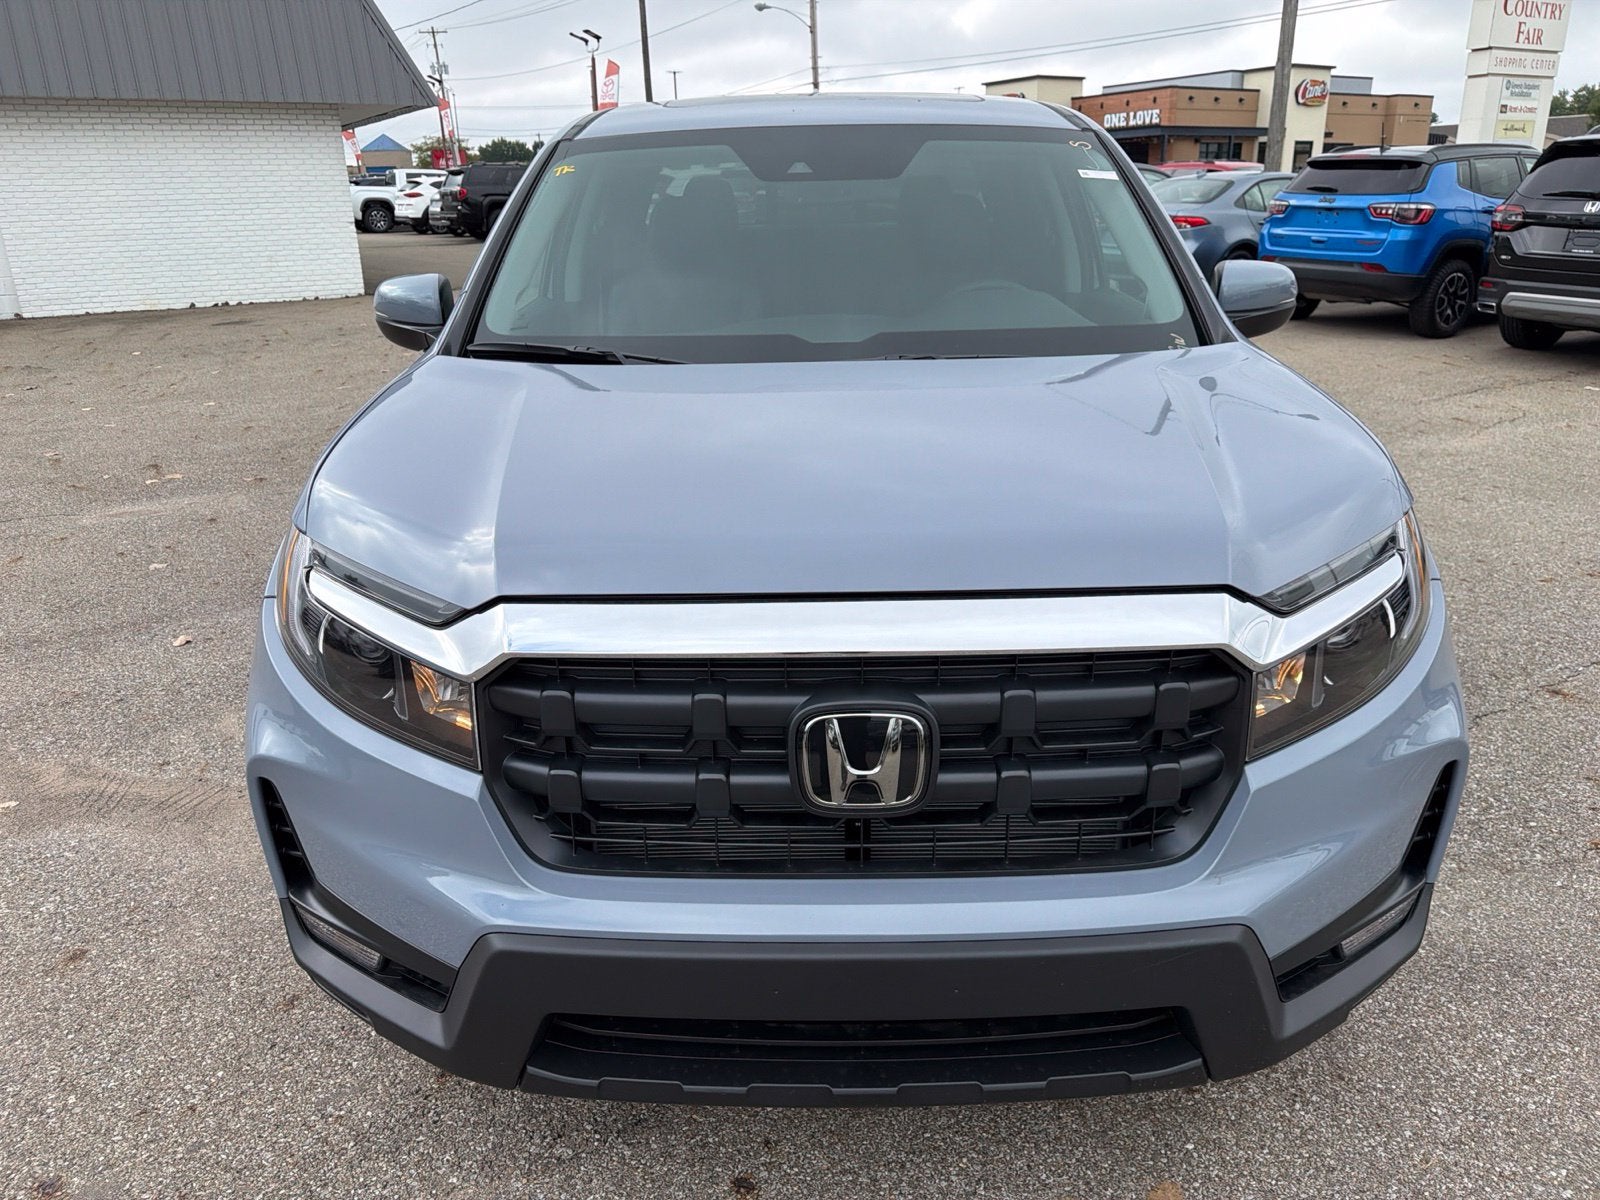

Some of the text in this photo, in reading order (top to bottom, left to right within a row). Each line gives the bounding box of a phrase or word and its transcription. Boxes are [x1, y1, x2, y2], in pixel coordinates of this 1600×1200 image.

[1503, 0, 1566, 20] COUNTRY
[1515, 21, 1544, 45] FAIR
[1494, 56, 1556, 70] SHOPPING CENTER
[1103, 109, 1160, 128] ONE LOVE
